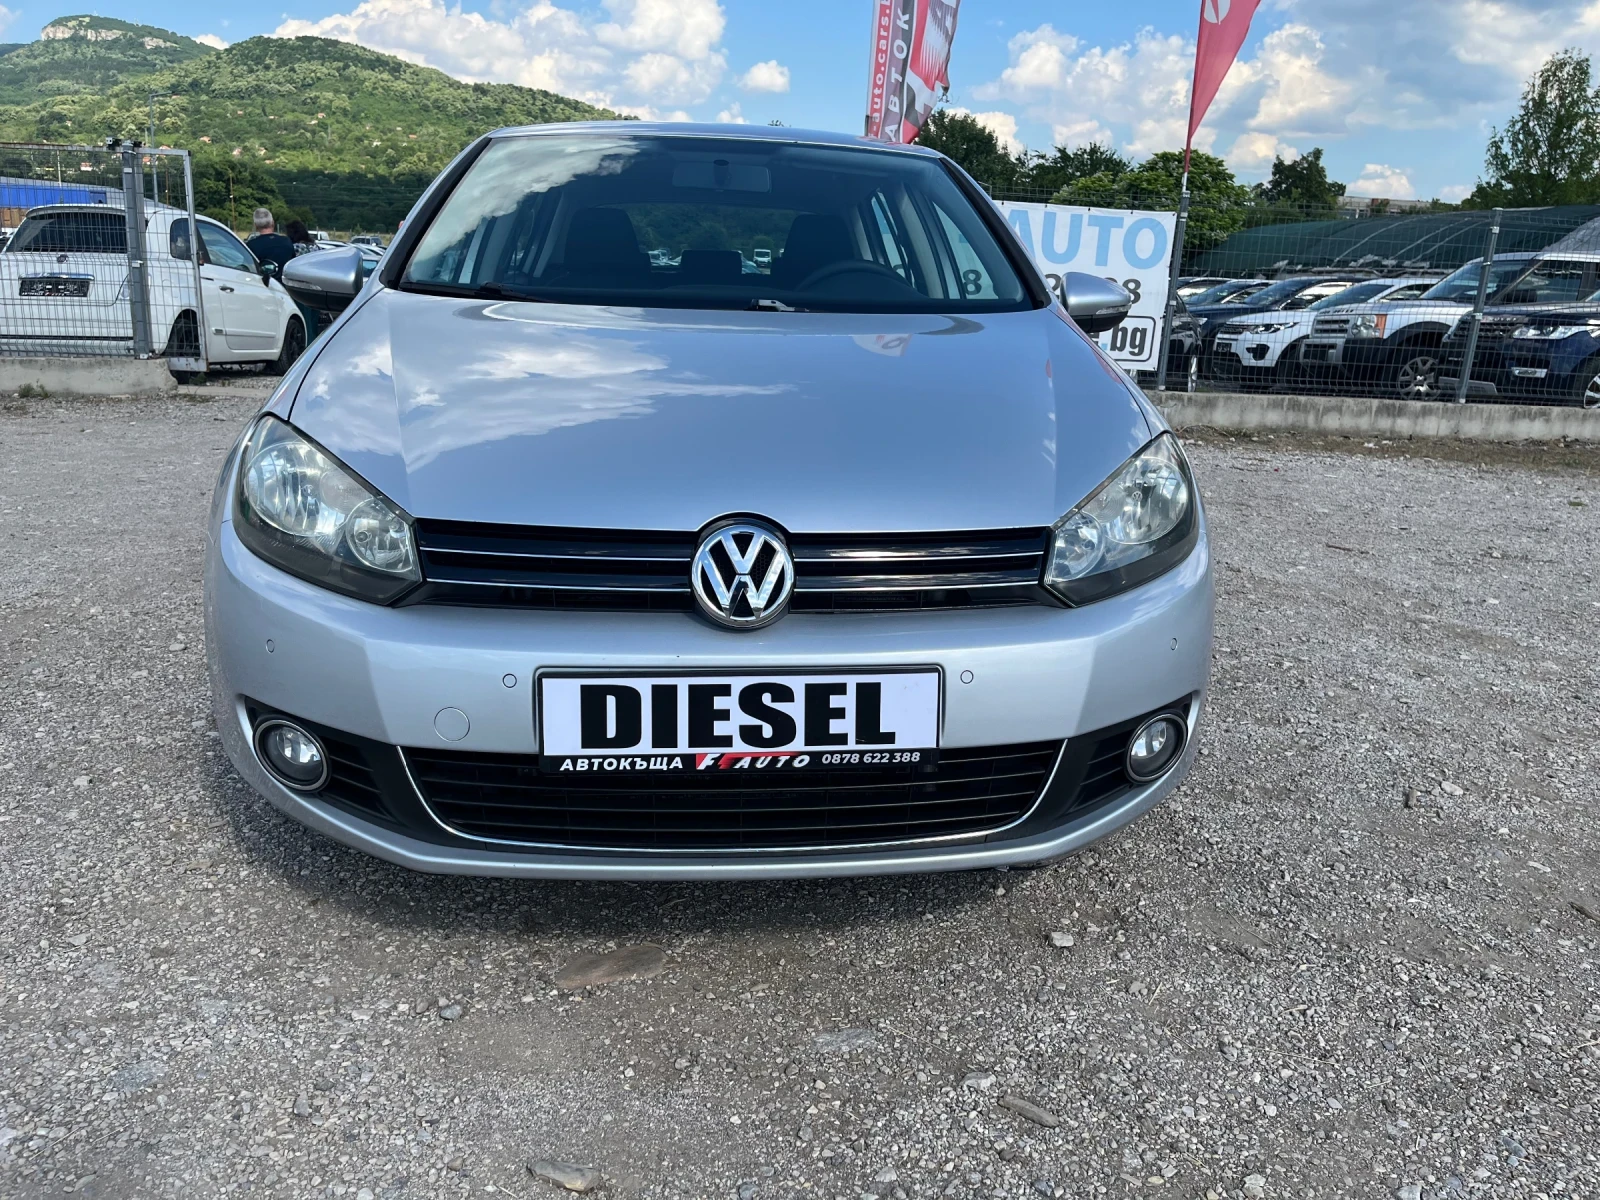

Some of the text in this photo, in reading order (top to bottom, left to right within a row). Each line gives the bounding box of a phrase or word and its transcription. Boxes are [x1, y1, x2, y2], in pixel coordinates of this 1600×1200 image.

[580, 682, 896, 749] DIESEL
[560, 757, 683, 771] АВТОКЪЩА
[733, 755, 810, 769] AUTO
[822, 753, 860, 764] 0878
[863, 752, 890, 764] 622
[892, 751, 921, 763] 388
